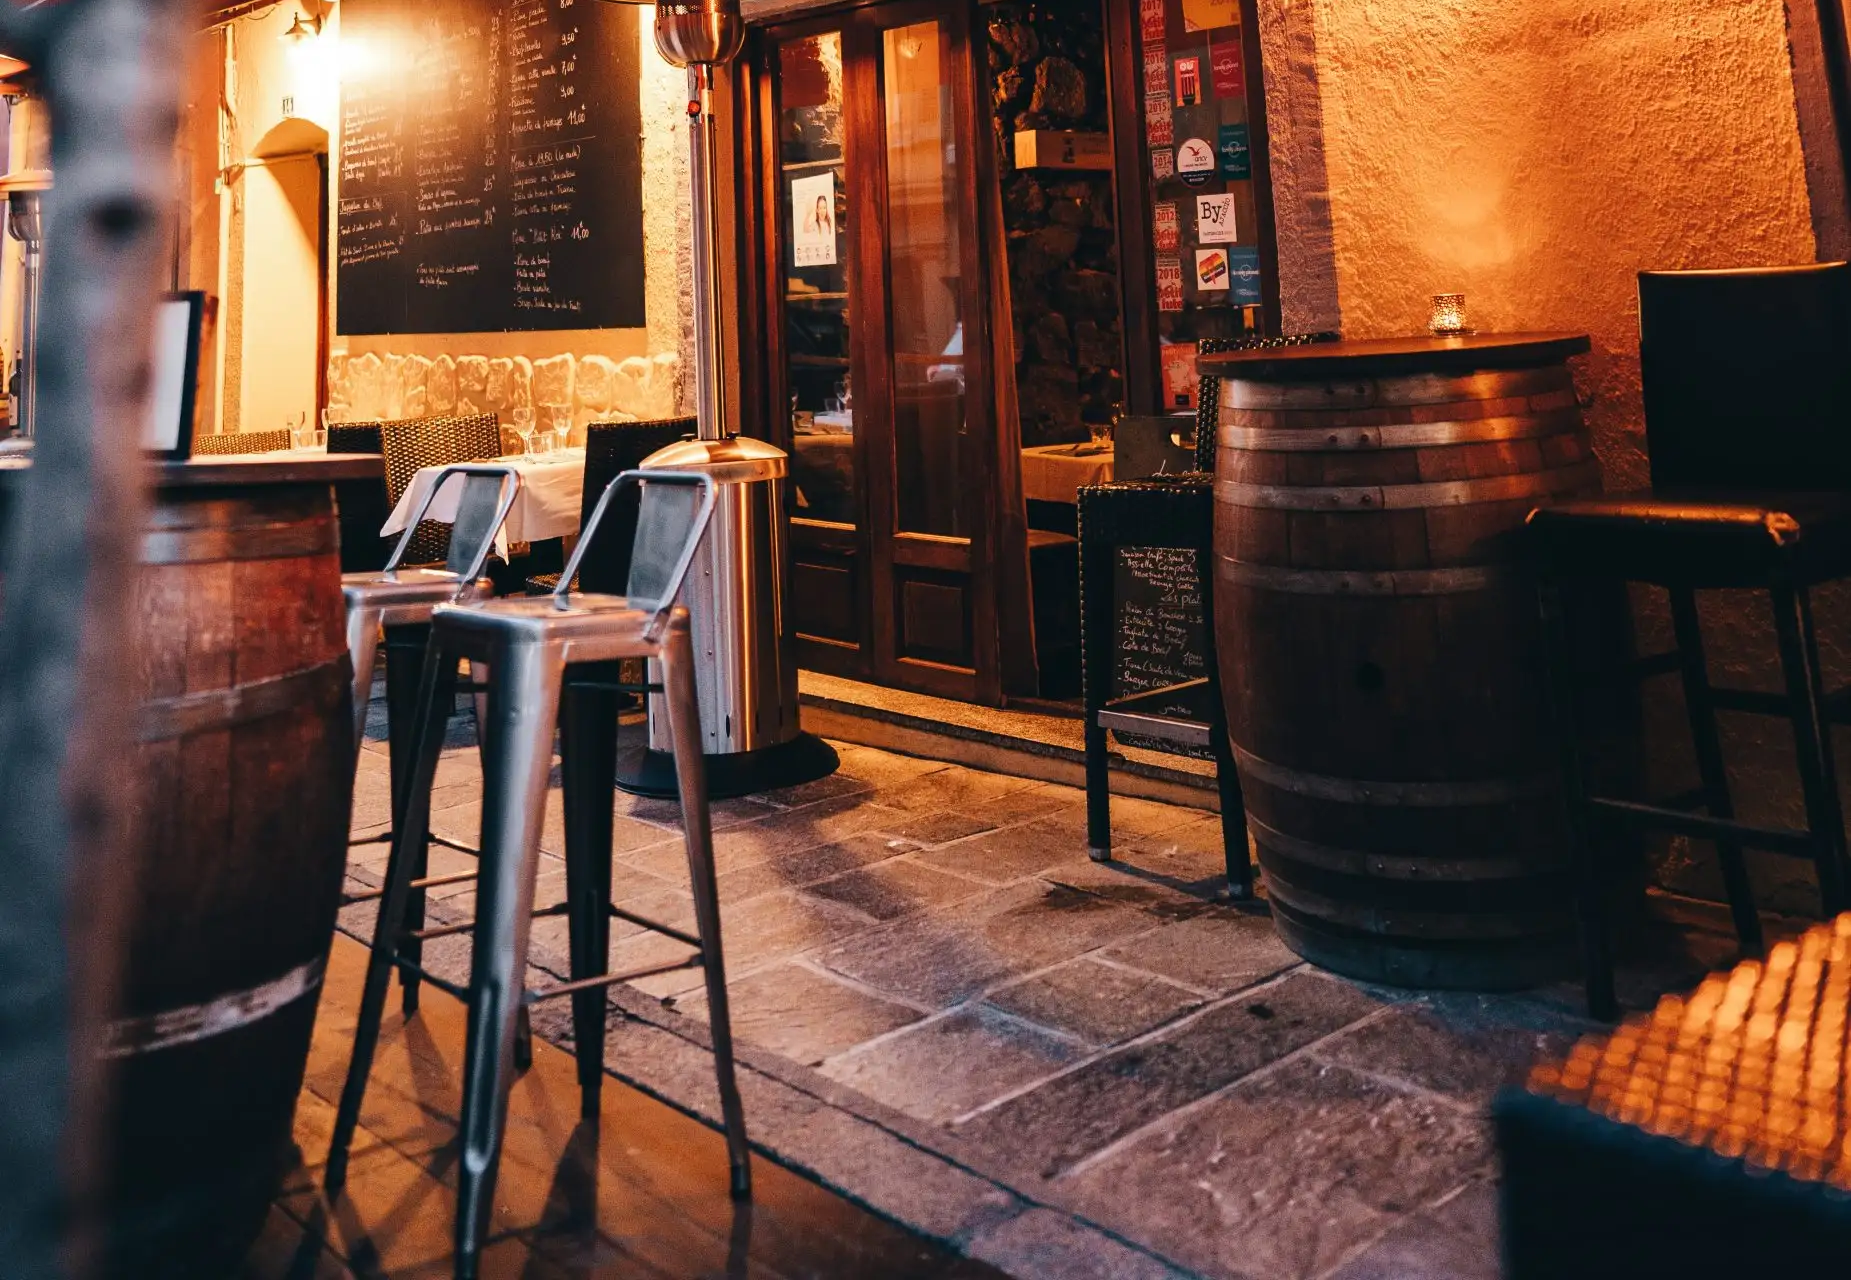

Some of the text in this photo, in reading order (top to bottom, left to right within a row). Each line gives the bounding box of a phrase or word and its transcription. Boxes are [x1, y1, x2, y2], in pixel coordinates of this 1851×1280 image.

[1142, 0, 1162, 11] 2017
[1201, 201, 1222, 224] By
[1159, 268, 1180, 280] 2018
